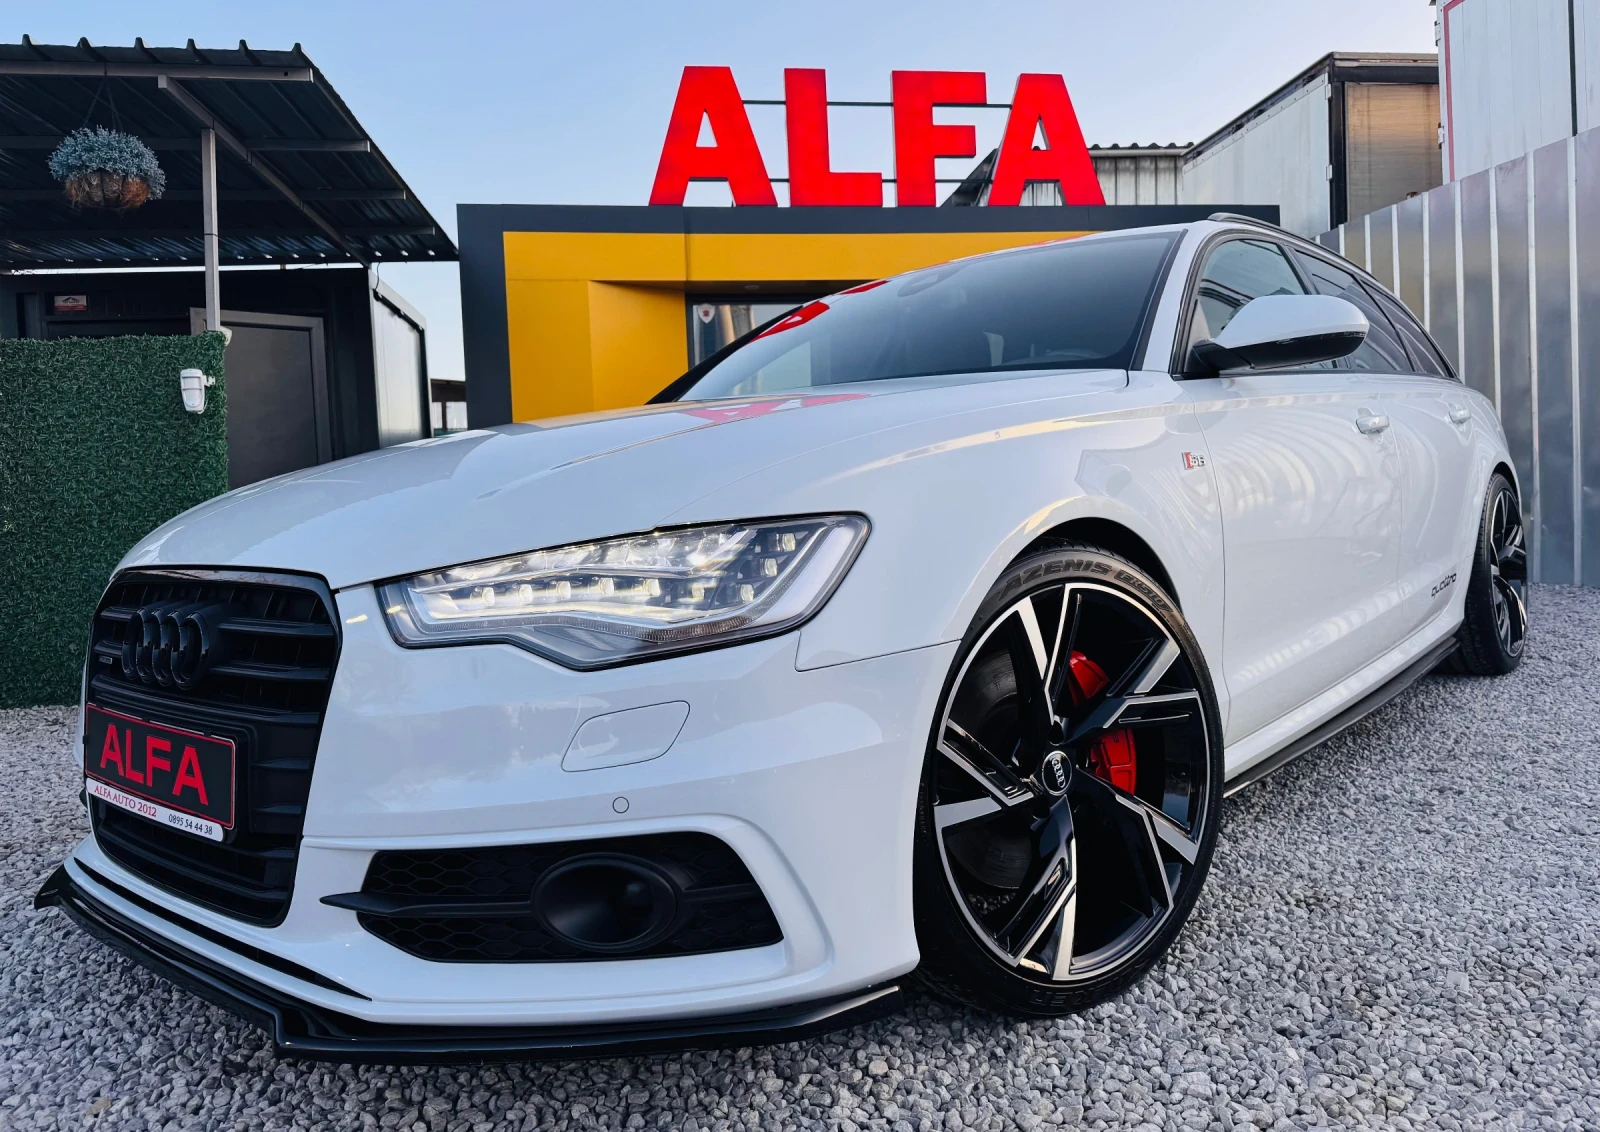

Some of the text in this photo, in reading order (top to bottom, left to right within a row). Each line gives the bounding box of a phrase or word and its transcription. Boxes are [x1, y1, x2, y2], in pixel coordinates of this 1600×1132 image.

[648, 65, 1106, 206] ALFA
[998, 558, 1114, 601] AZENIS
[99, 723, 209, 806] ALFA
[94, 785, 213, 835] ALFA AUTO 2012 0895 54 44 38
